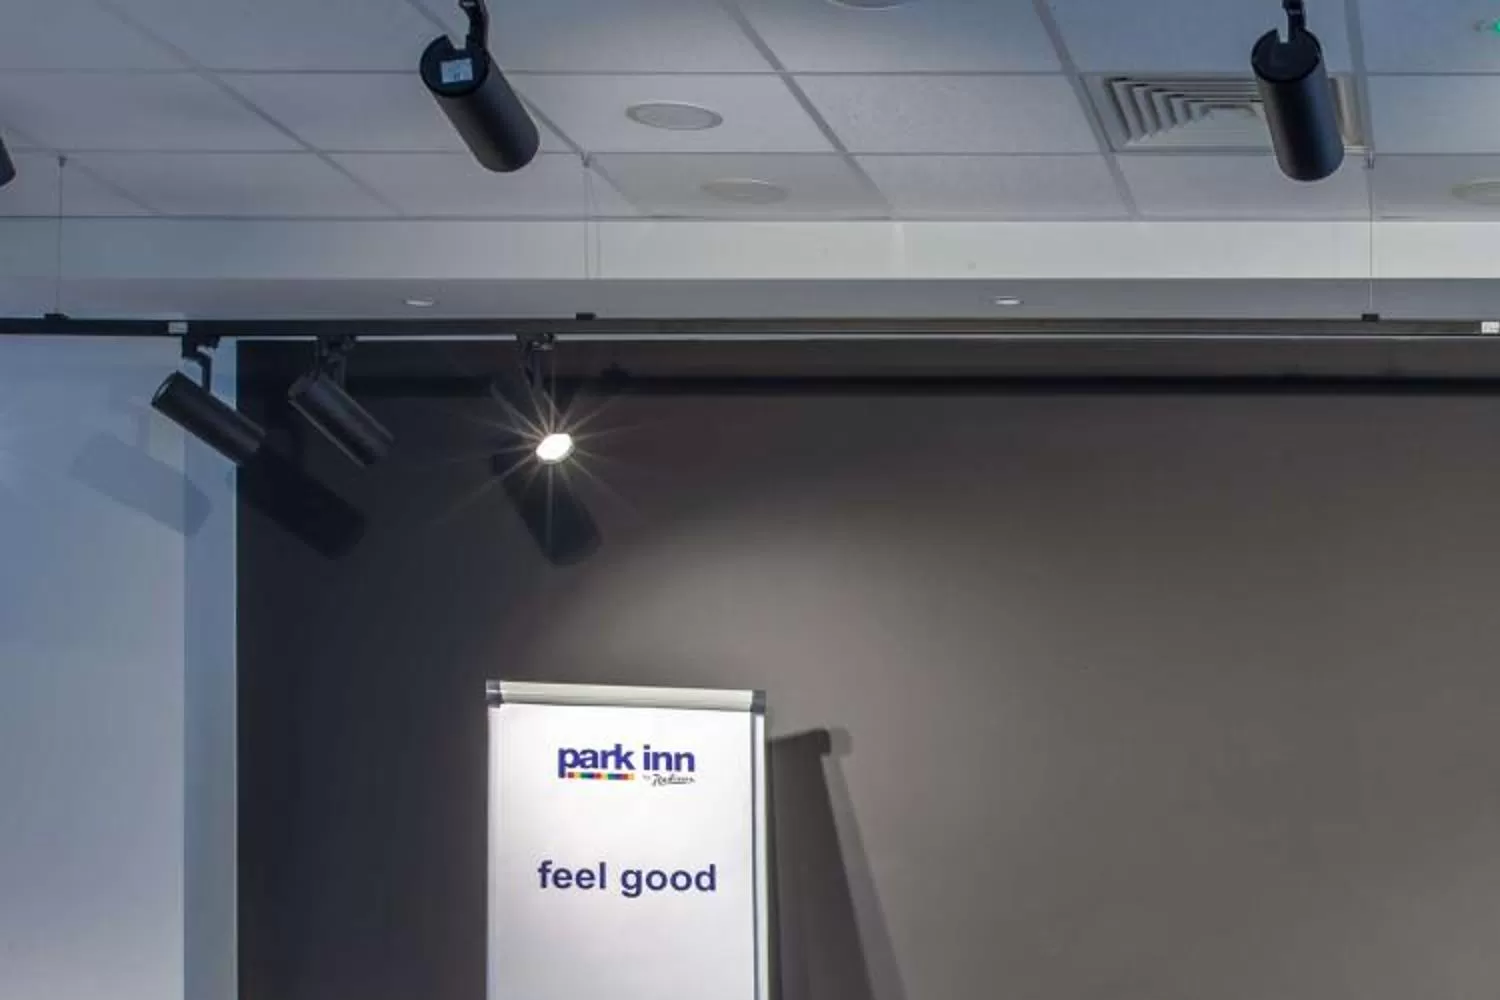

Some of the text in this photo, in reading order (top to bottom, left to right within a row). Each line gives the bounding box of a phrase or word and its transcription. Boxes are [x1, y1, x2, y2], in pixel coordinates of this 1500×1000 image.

[557, 743, 696, 779] park inn
[537, 859, 717, 899] feel good
